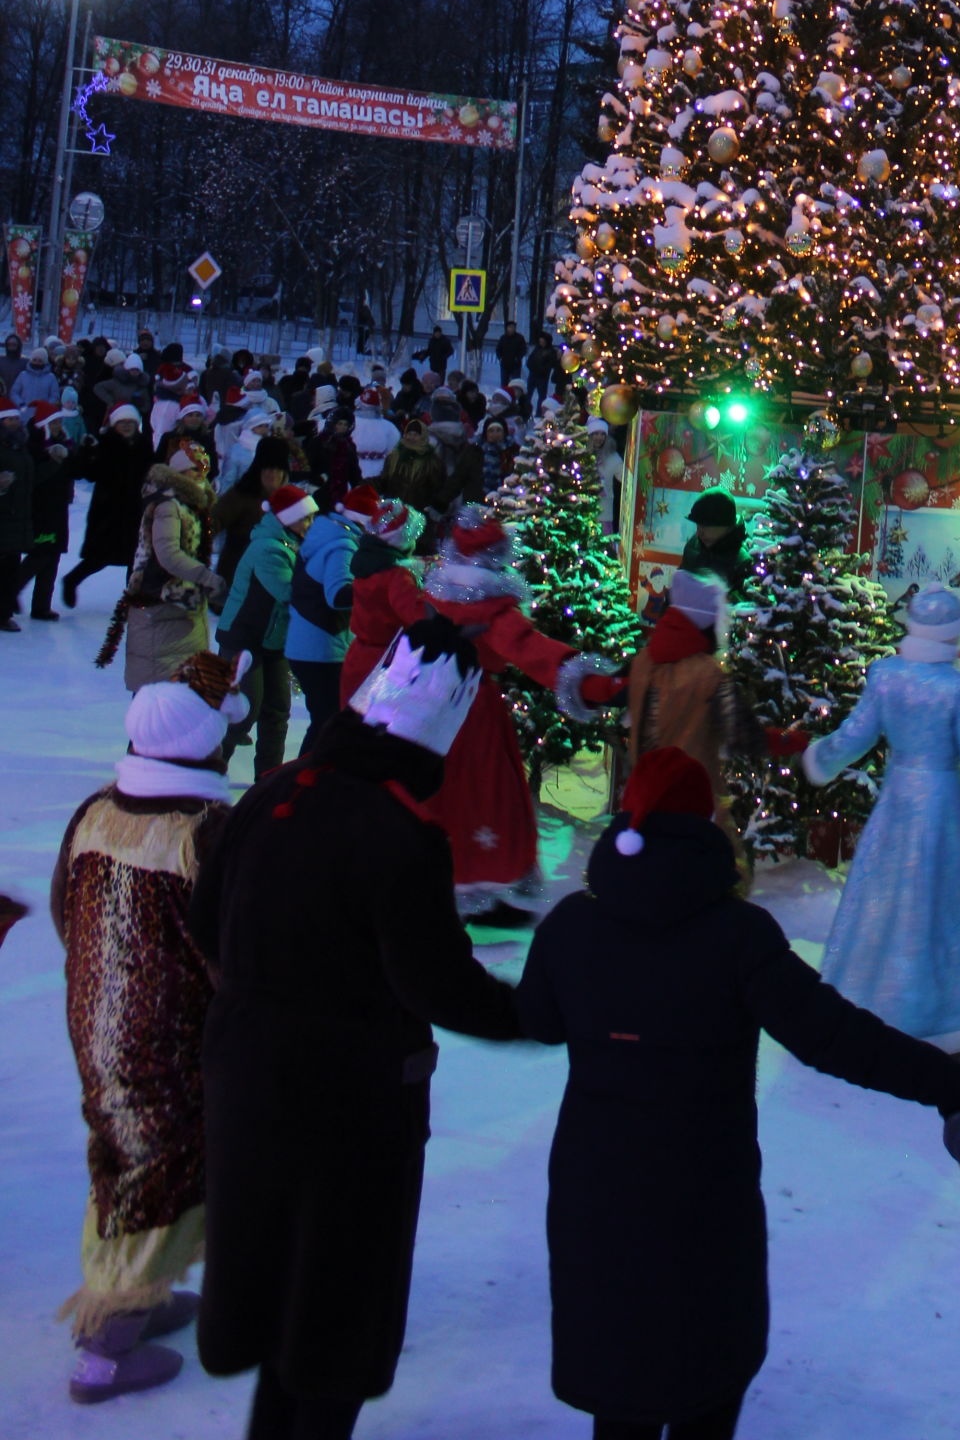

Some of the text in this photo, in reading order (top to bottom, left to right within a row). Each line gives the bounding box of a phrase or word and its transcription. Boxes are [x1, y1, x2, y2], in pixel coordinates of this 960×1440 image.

[192, 75, 244, 105] Яңа
[256, 89, 286, 110] ел
[292, 95, 424, 128] тамашасы
[218, 66, 266, 86] декабрь
[274, 73, 304, 90] 19:00
[311, 79, 344, 97] Район
